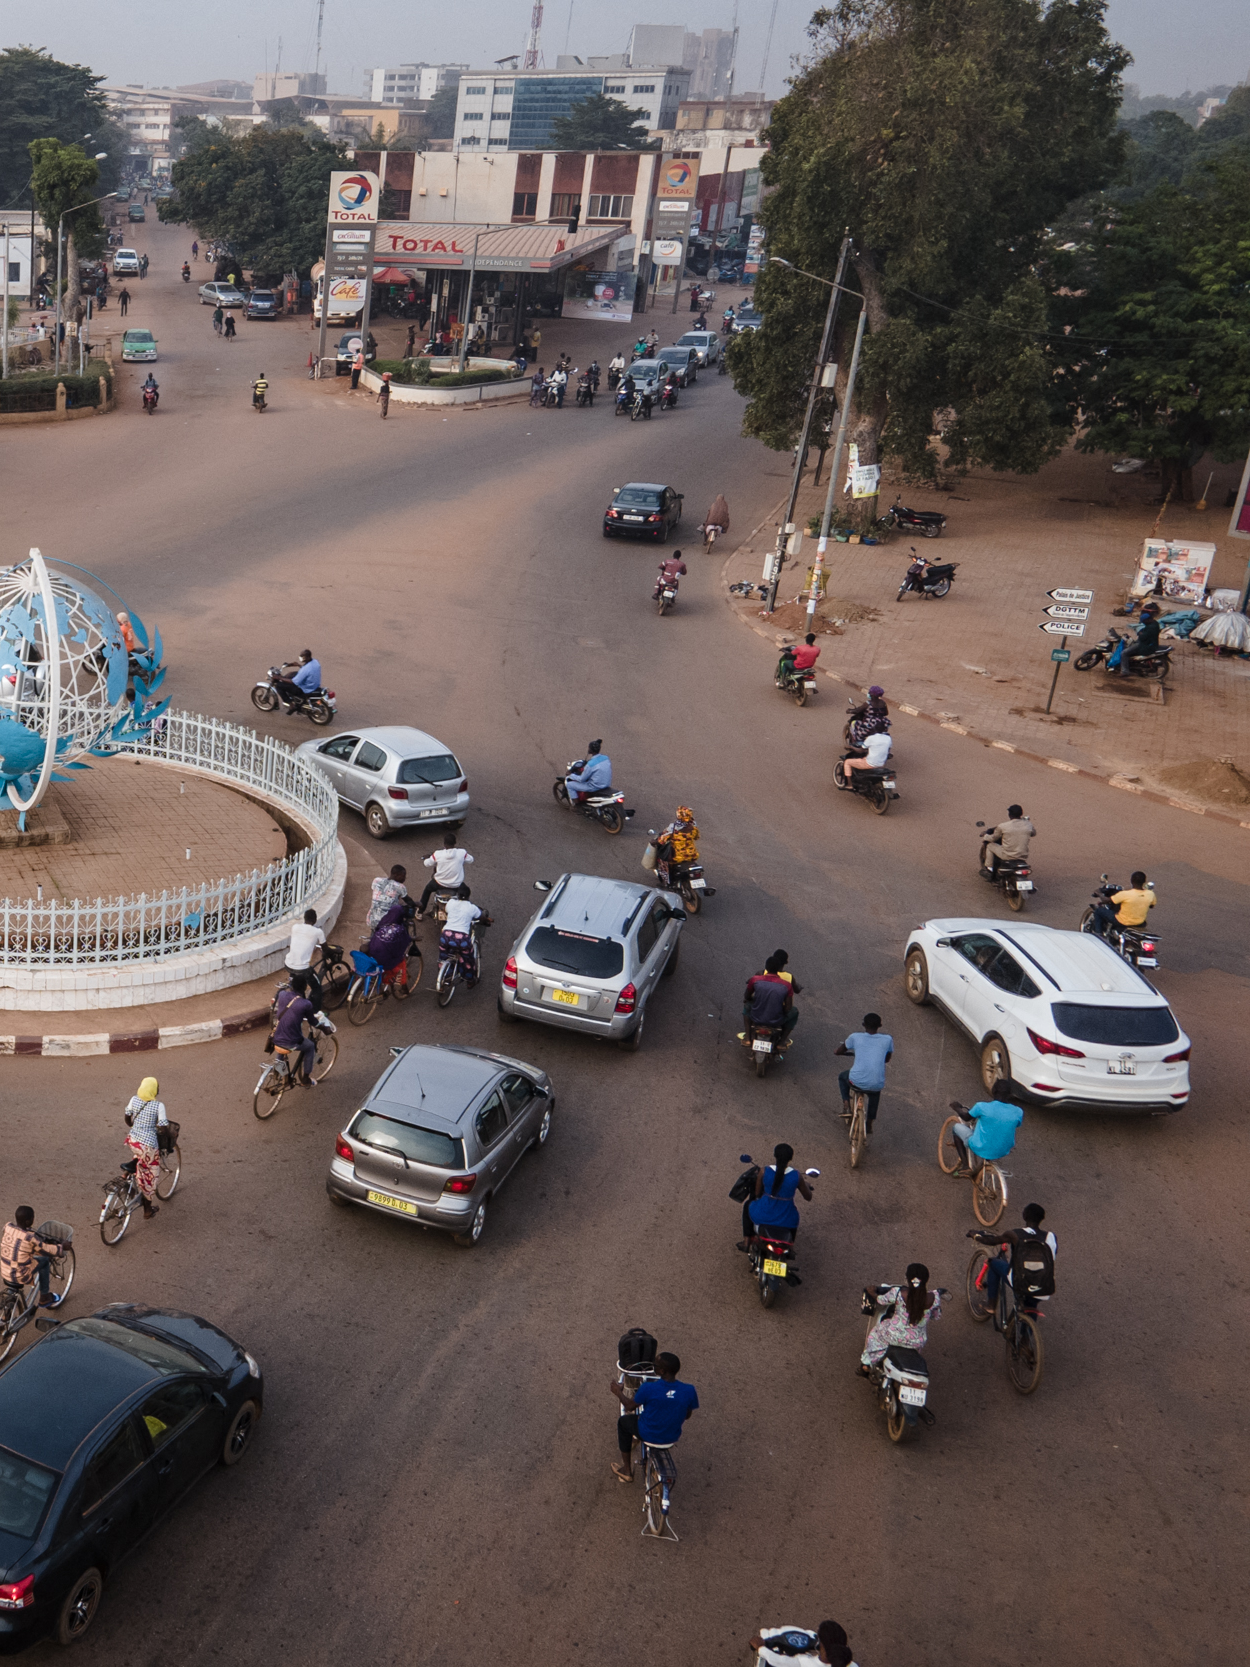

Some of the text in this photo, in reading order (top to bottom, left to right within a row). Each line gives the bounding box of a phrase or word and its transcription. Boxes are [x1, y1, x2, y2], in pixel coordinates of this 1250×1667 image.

[661, 187, 692, 195] TOTAL
[331, 210, 375, 221] TOTAL
[388, 235, 463, 253] TOTAL
[330, 280, 361, 298] Café
[1050, 622, 1081, 631] POLICE
